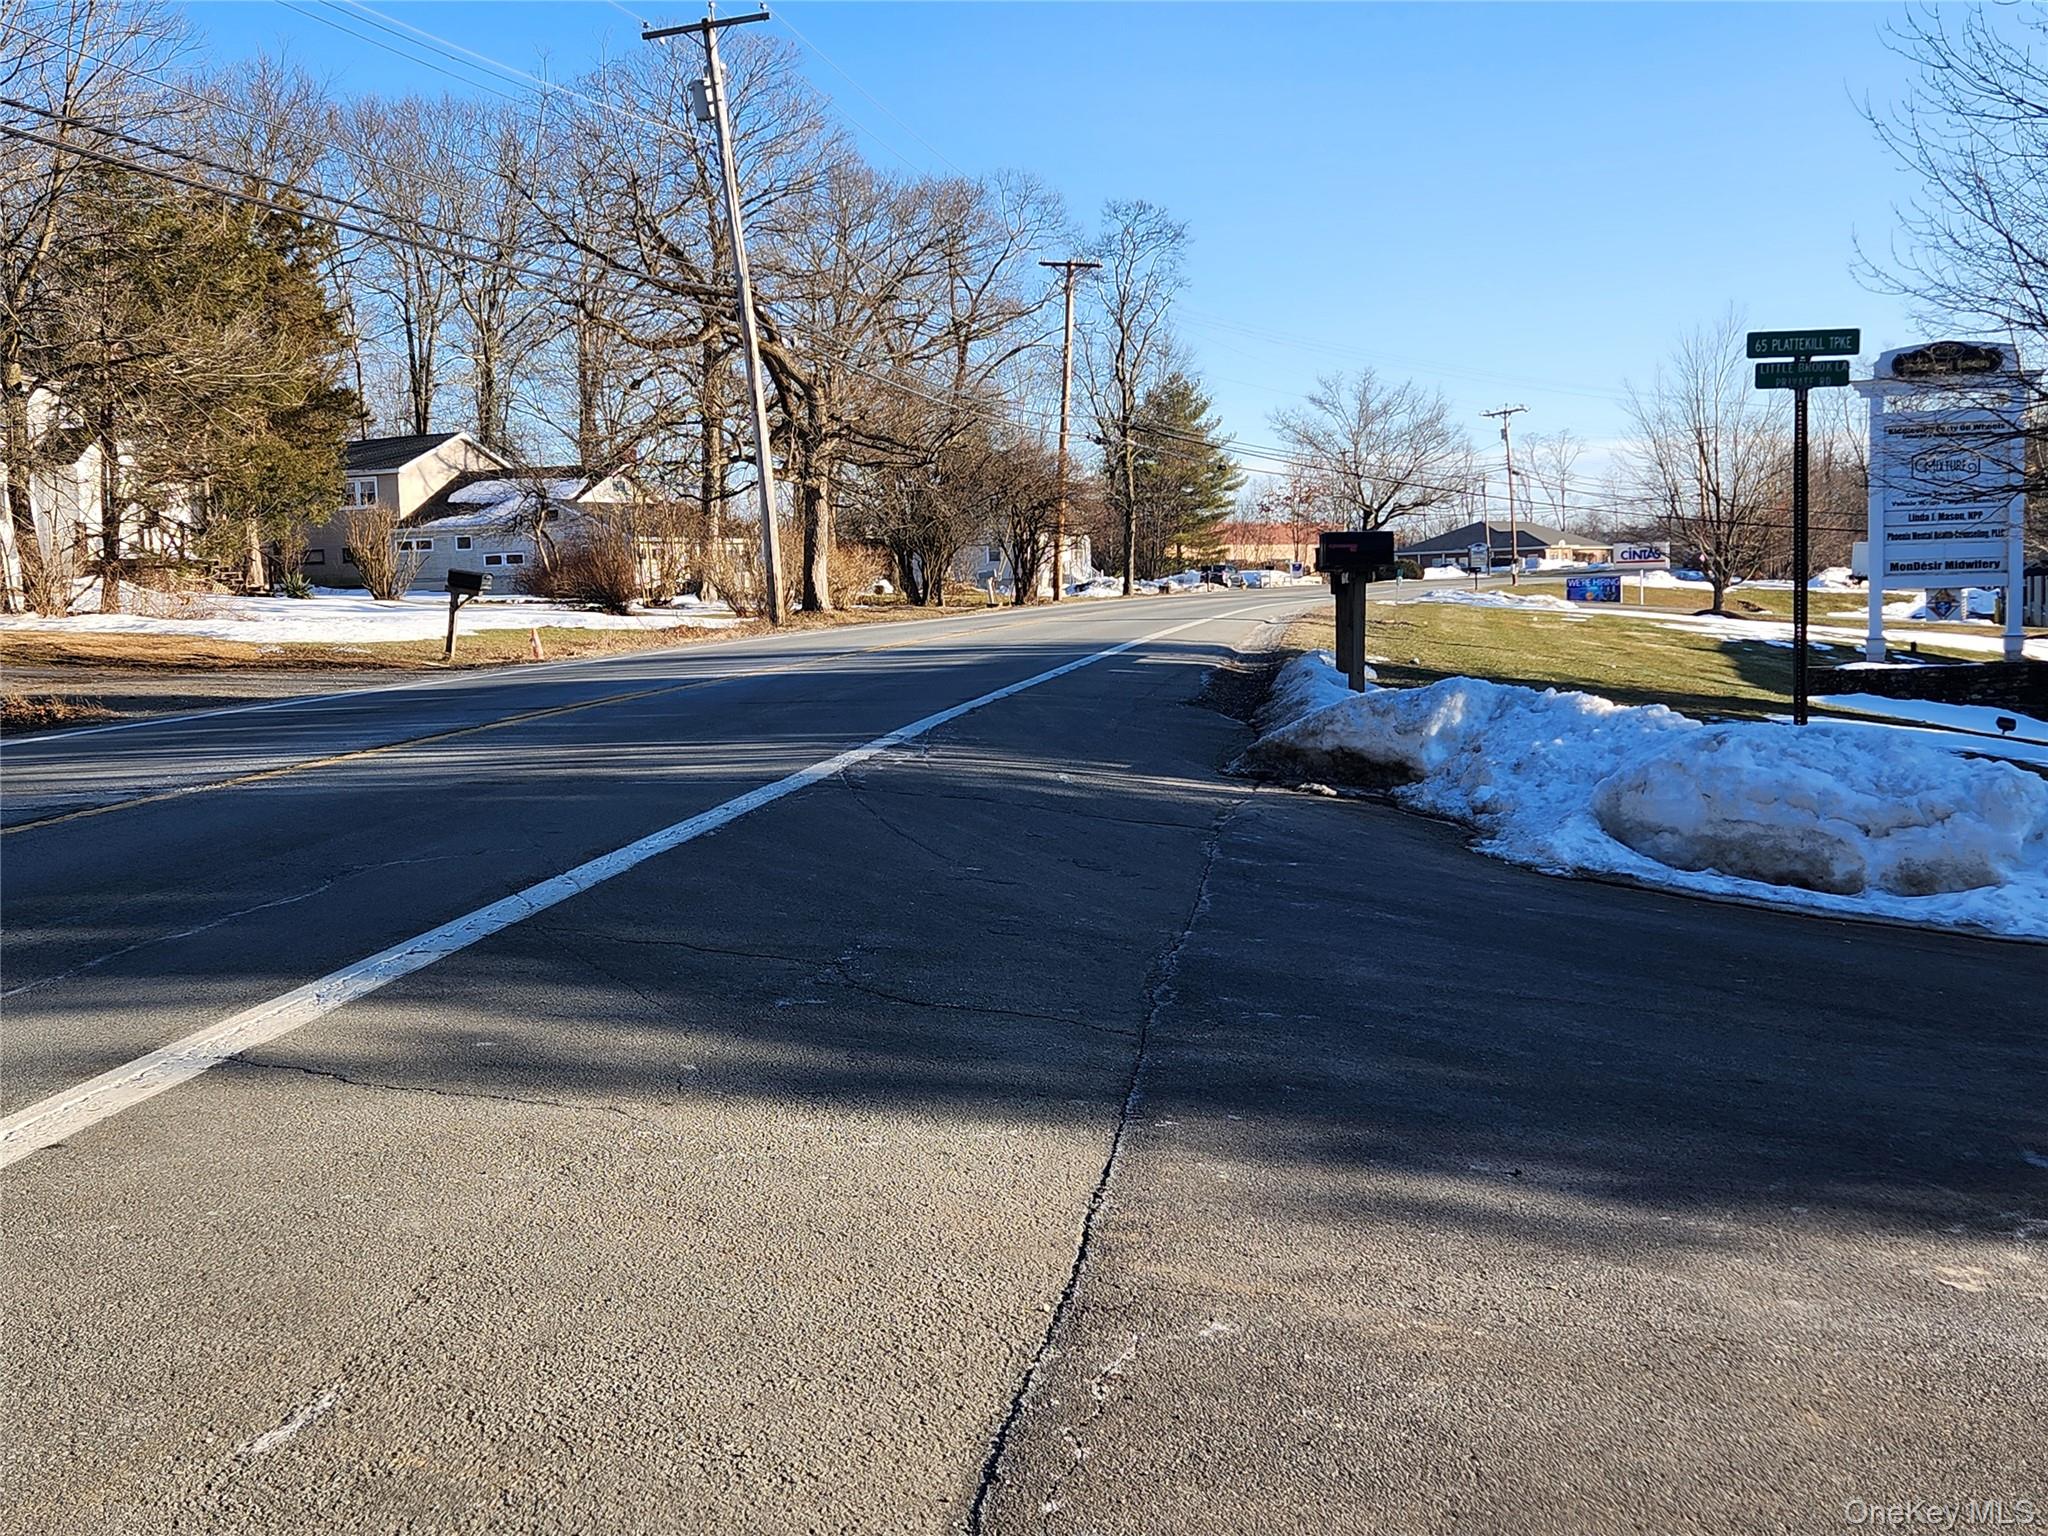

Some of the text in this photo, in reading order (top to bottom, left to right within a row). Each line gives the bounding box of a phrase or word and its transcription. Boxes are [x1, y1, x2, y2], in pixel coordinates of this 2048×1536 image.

[1755, 335, 1853, 352] 65 PLATTEKILL TPKE
[1760, 363, 1793, 374] LITTLE
[1798, 362, 1832, 373] BROOK
[1908, 513, 1930, 522] Linda
[1945, 559, 2000, 571] Midwifery
